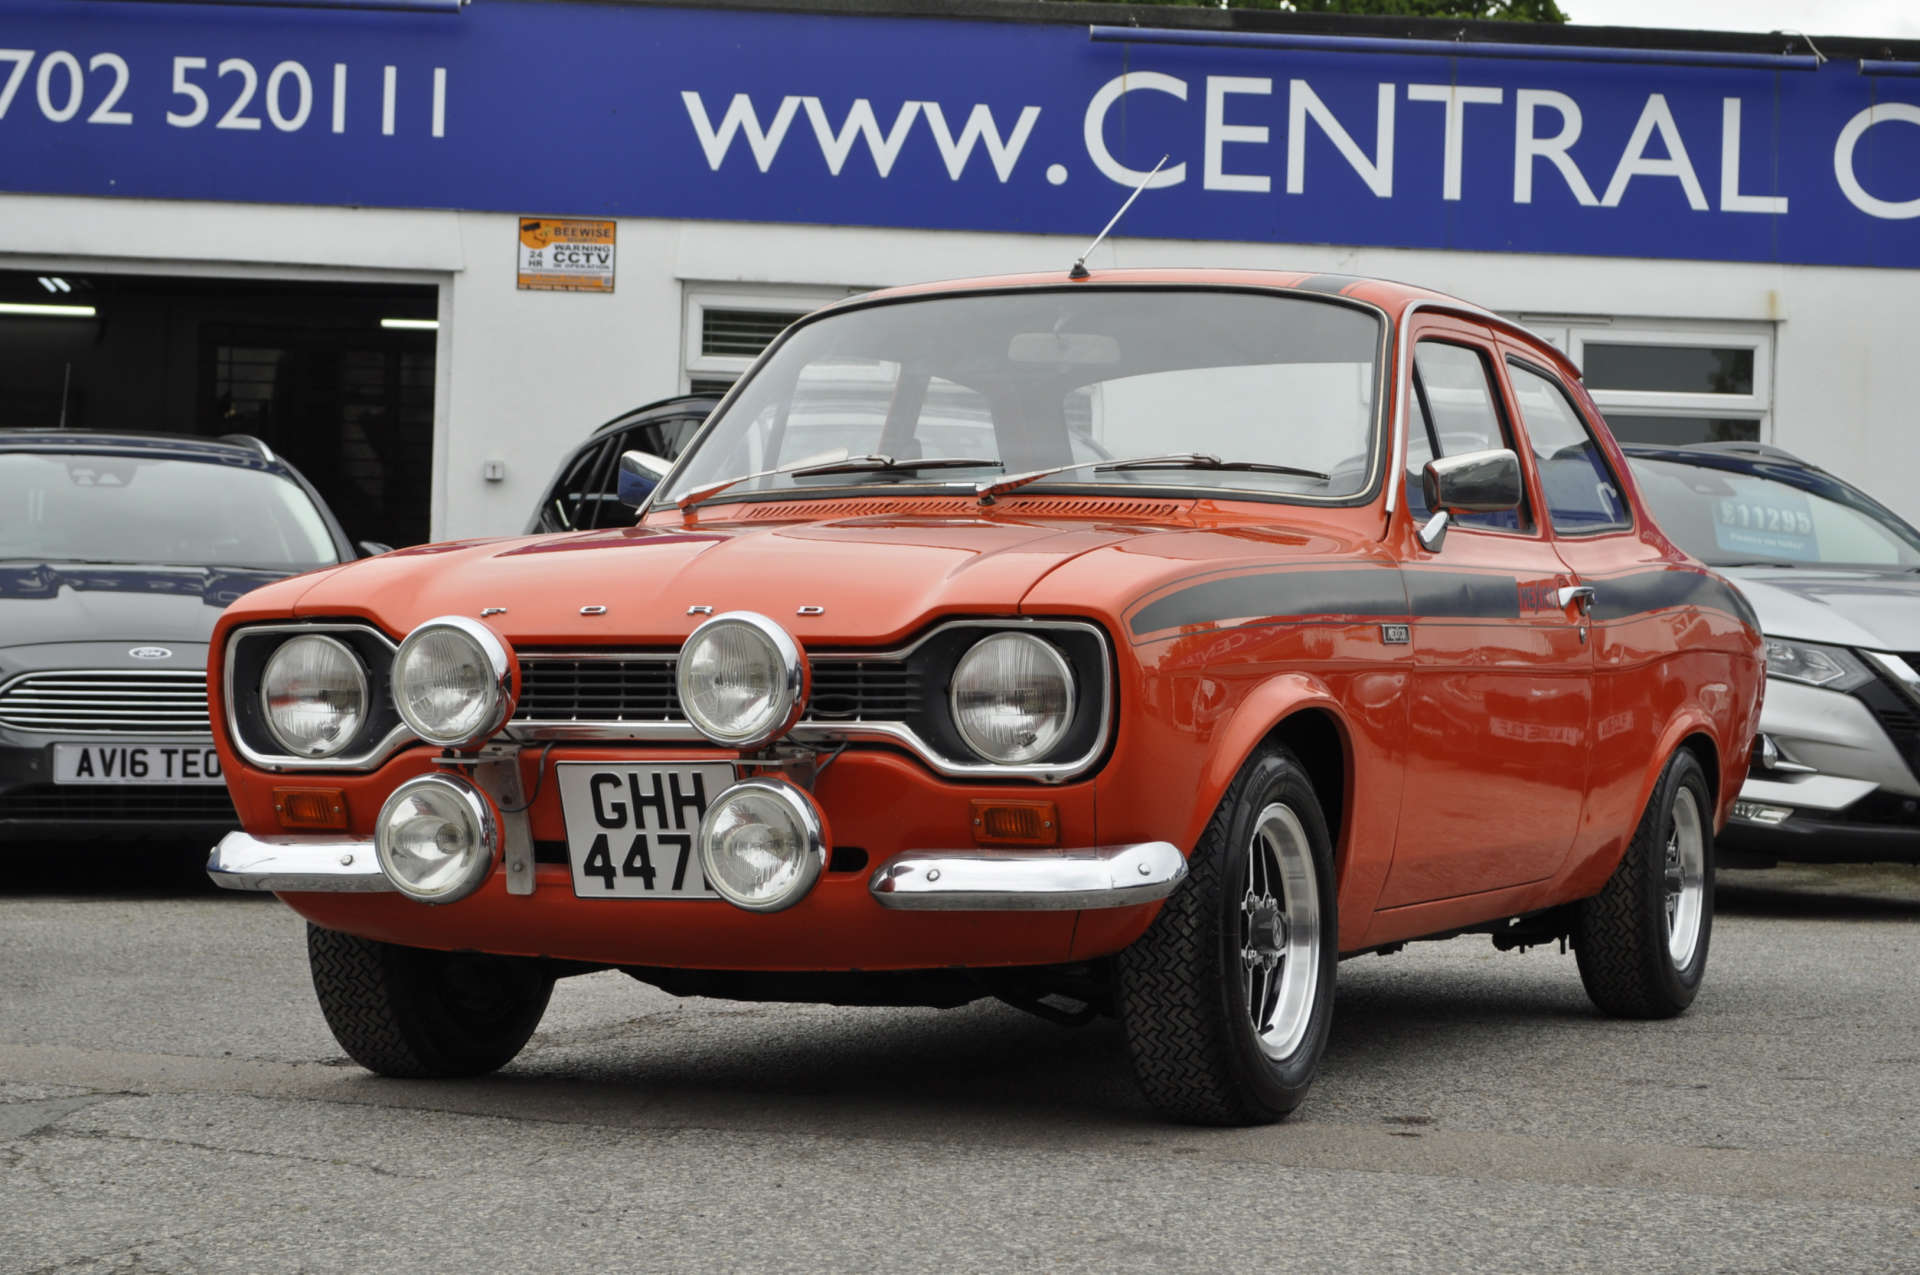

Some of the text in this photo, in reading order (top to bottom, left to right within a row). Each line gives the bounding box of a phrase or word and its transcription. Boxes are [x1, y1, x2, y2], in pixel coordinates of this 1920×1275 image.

[166, 57, 447, 138] 520111
[554, 227, 611, 238] BEEWISE
[529, 250, 543, 259] 24
[553, 251, 610, 264] CCTV
[554, 244, 610, 252] WARNING
[528, 259, 543, 267] HR
[1720, 501, 1813, 534] £11295
[76, 748, 149, 778] AV16
[589, 772, 709, 831] GHH
[583, 833, 717, 891] 447
